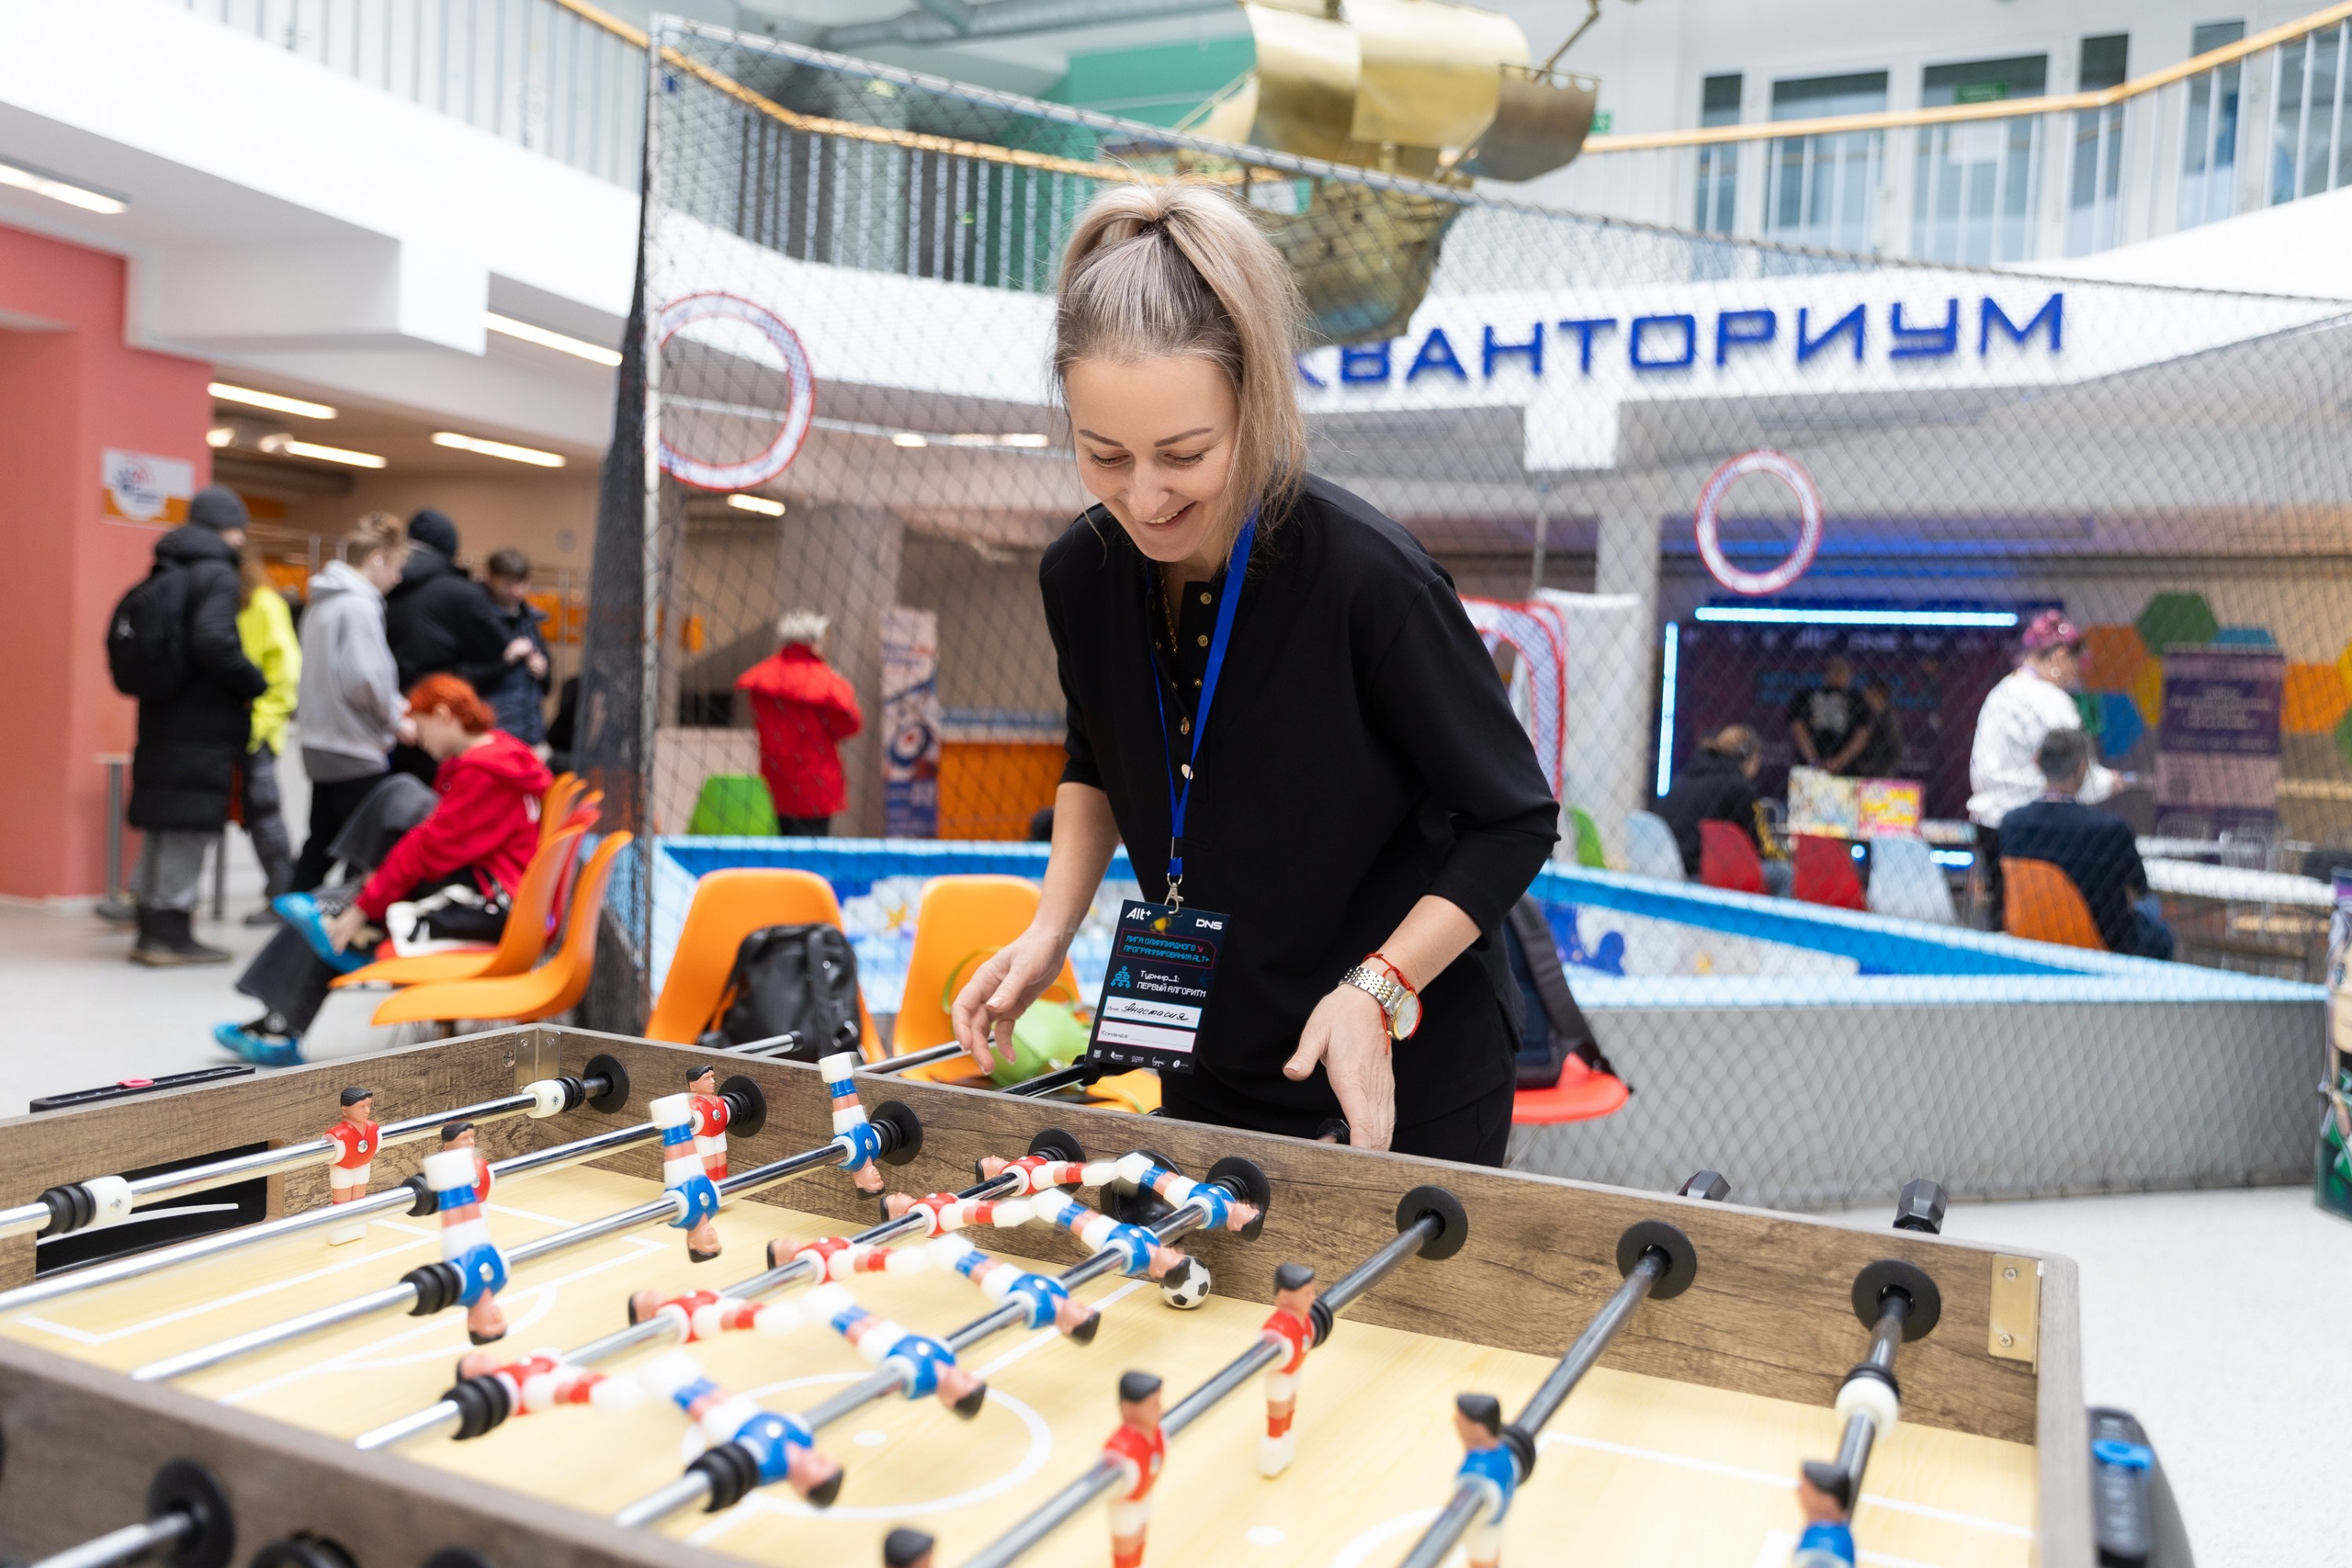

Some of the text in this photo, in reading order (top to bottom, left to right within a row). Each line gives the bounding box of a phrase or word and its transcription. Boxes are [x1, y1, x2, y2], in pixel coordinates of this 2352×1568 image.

[1125, 907, 1152, 920] Alt+
[1195, 918, 1223, 931] DNS
[1125, 935, 1144, 944] ЛИГА
[1123, 944, 1192, 961] ПРОГРАММИРОВАНИЯ
[1136, 981, 1206, 998] ПЕРВЫЙ АЛГОРИТМ
[1121, 1002, 1189, 1021] Анастасия
